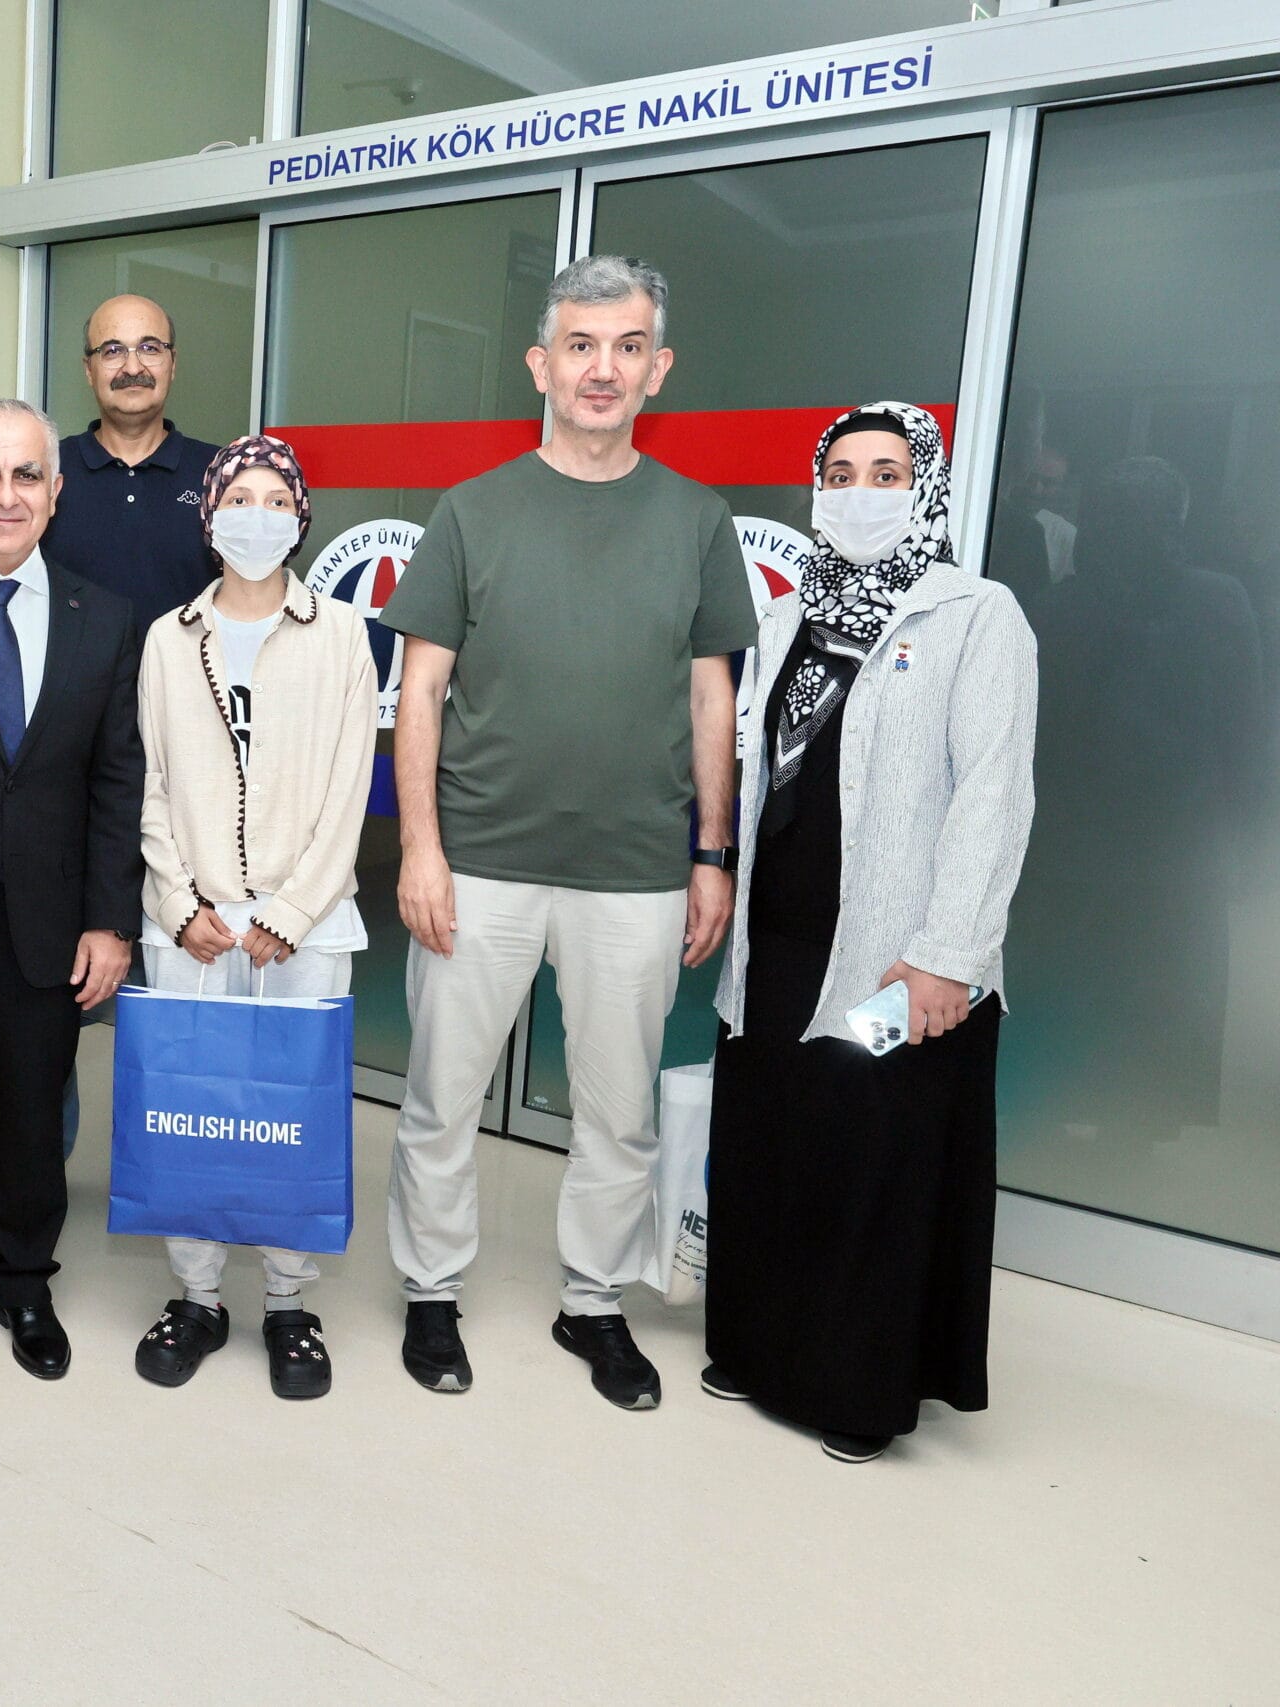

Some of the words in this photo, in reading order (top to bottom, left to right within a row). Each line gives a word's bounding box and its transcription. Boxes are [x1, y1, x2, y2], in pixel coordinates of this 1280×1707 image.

[269, 135, 417, 185] PEDİATRİK
[427, 124, 496, 162] KÖK
[506, 105, 625, 149] HÜCRE
[638, 79, 752, 128] NAKİL
[766, 46, 933, 109] ÜNİTESİ
[146, 1110, 234, 1141] ENGLISH
[240, 1119, 302, 1145] HOME
